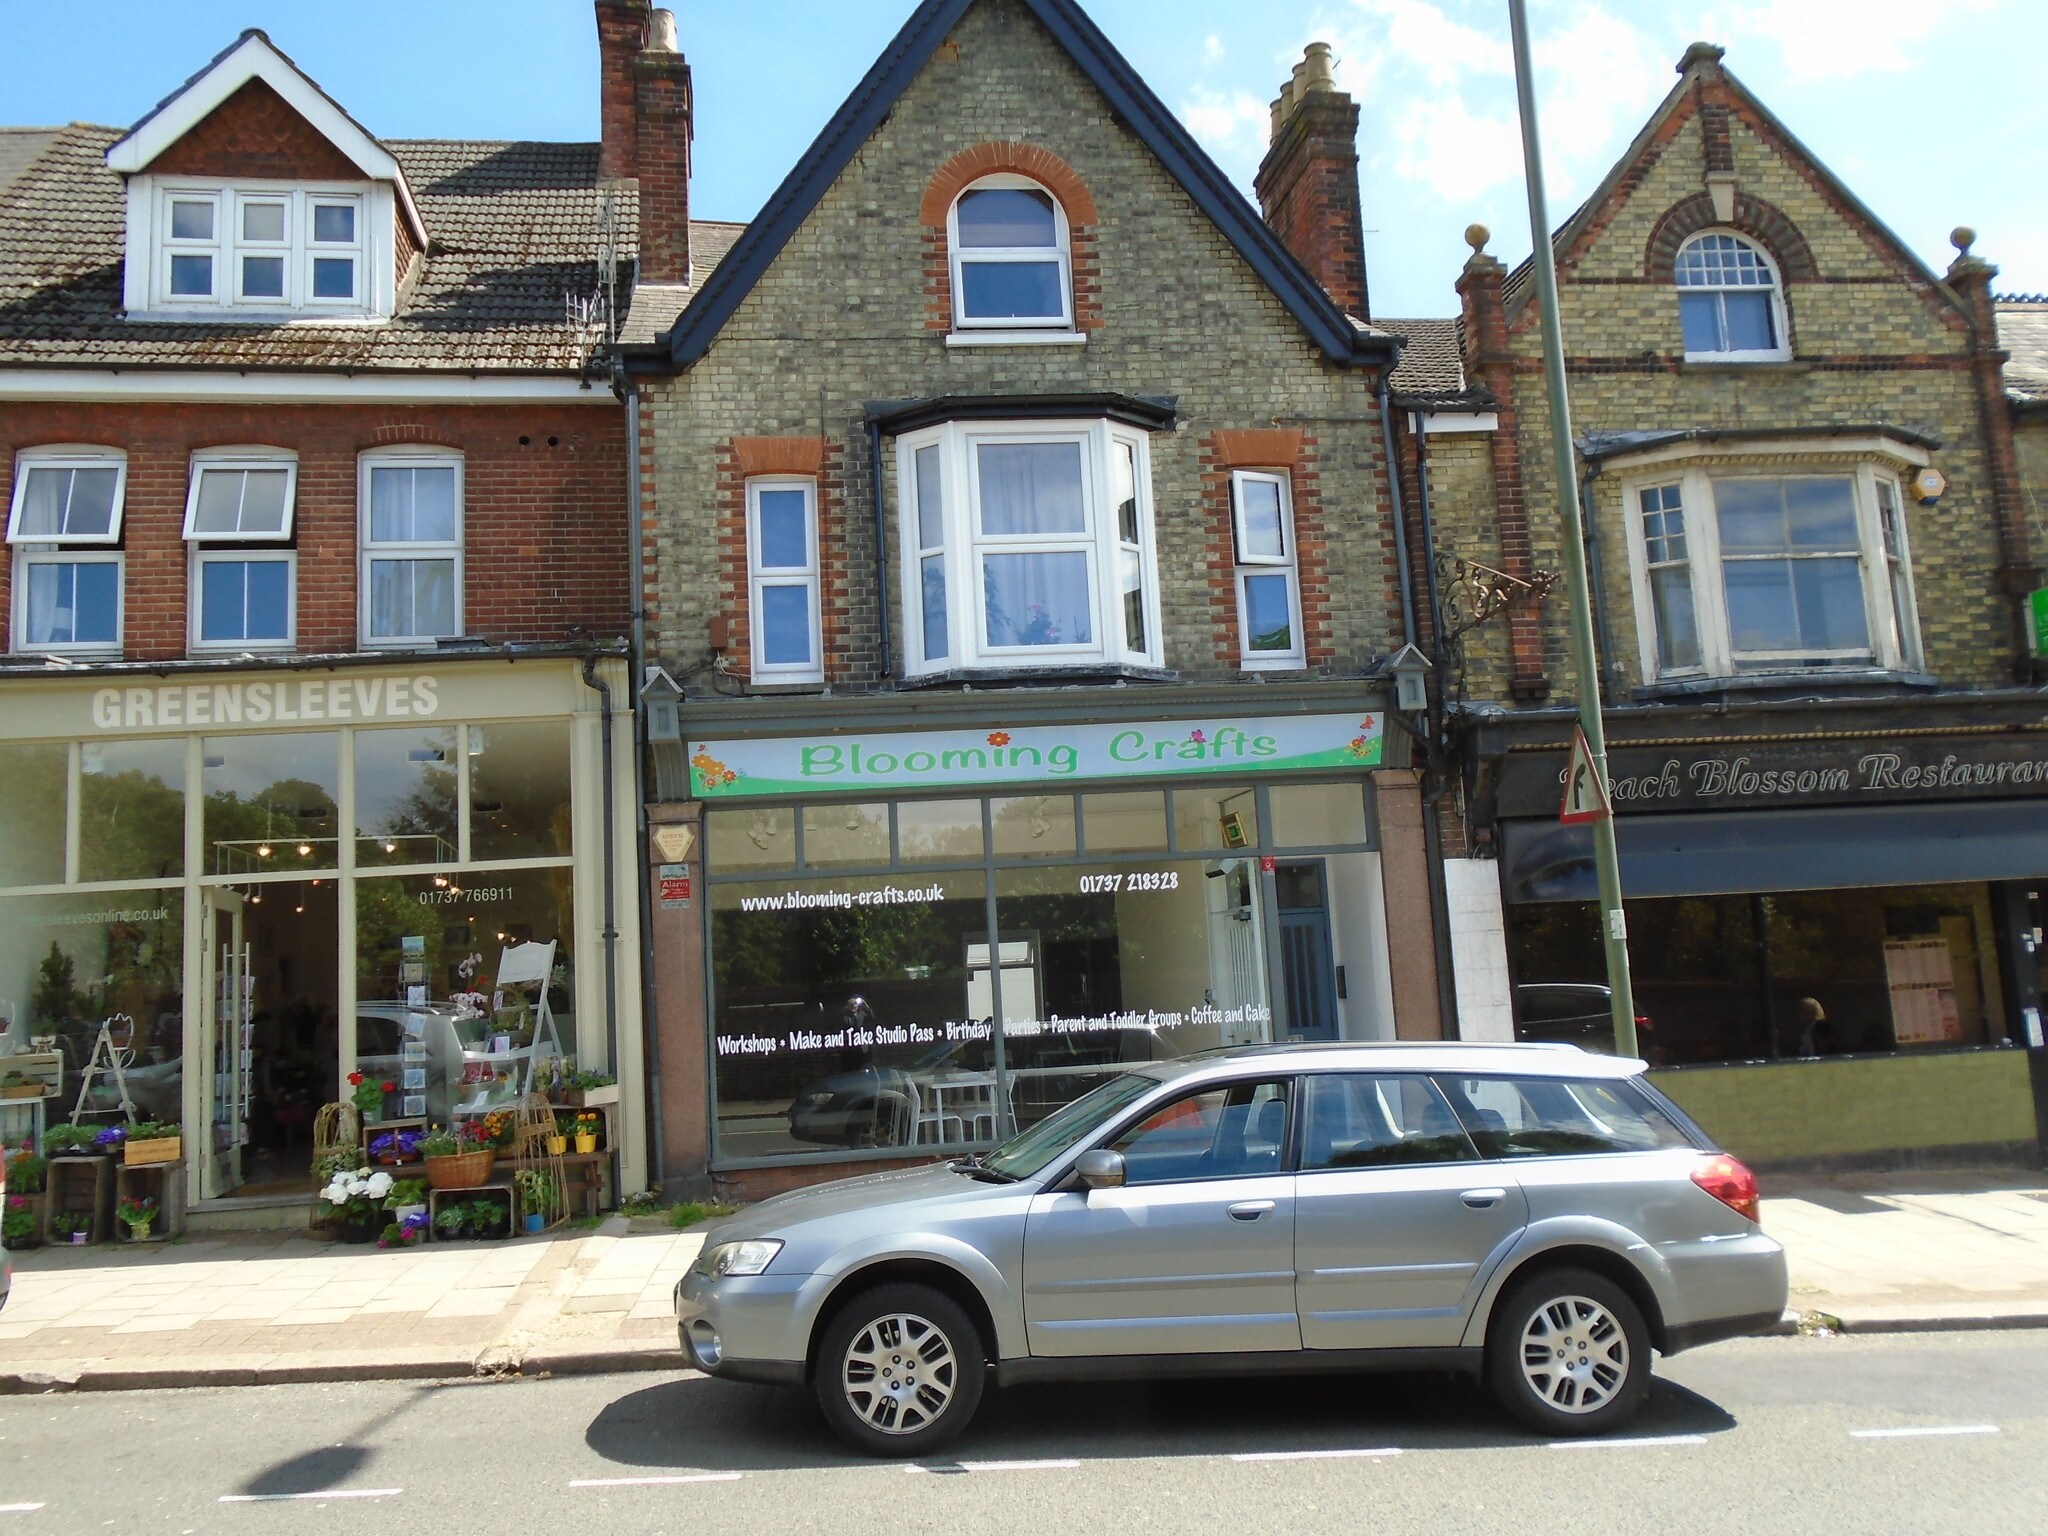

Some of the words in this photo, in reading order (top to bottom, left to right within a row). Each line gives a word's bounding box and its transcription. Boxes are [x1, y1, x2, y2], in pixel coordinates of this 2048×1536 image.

[92, 675, 439, 729] GREENSLEEVES
[799, 732, 1079, 777] Blooming
[1108, 726, 1278, 763] Crafts
[1559, 758, 1681, 801] each
[1688, 757, 1850, 797] Blossom
[465, 886, 513, 903] 766911
[662, 880, 689, 888] Alarm
[741, 883, 945, 912] www.blooming-crafts.co.uk
[1080, 874, 1123, 893] 01737
[1126, 871, 1179, 891] 218328
[717, 1033, 777, 1056] Workshops
[789, 1030, 822, 1050] Make
[824, 1029, 845, 1048] and
[846, 1027, 873, 1047] Take
[875, 1025, 908, 1045] Studio
[909, 1022, 934, 1042] Pass
[945, 1020, 991, 1041] Birthday
[1004, 1017, 1041, 1035] Parties
[1050, 1014, 1086, 1034] Parent
[1088, 1013, 1108, 1031] and
[1109, 1010, 1147, 1030] Toddler
[1148, 1008, 1182, 1030] Groups
[1191, 1005, 1223, 1024] Coffee
[1224, 1005, 1244, 1023] and
[1245, 1003, 1271, 1022] Cake
